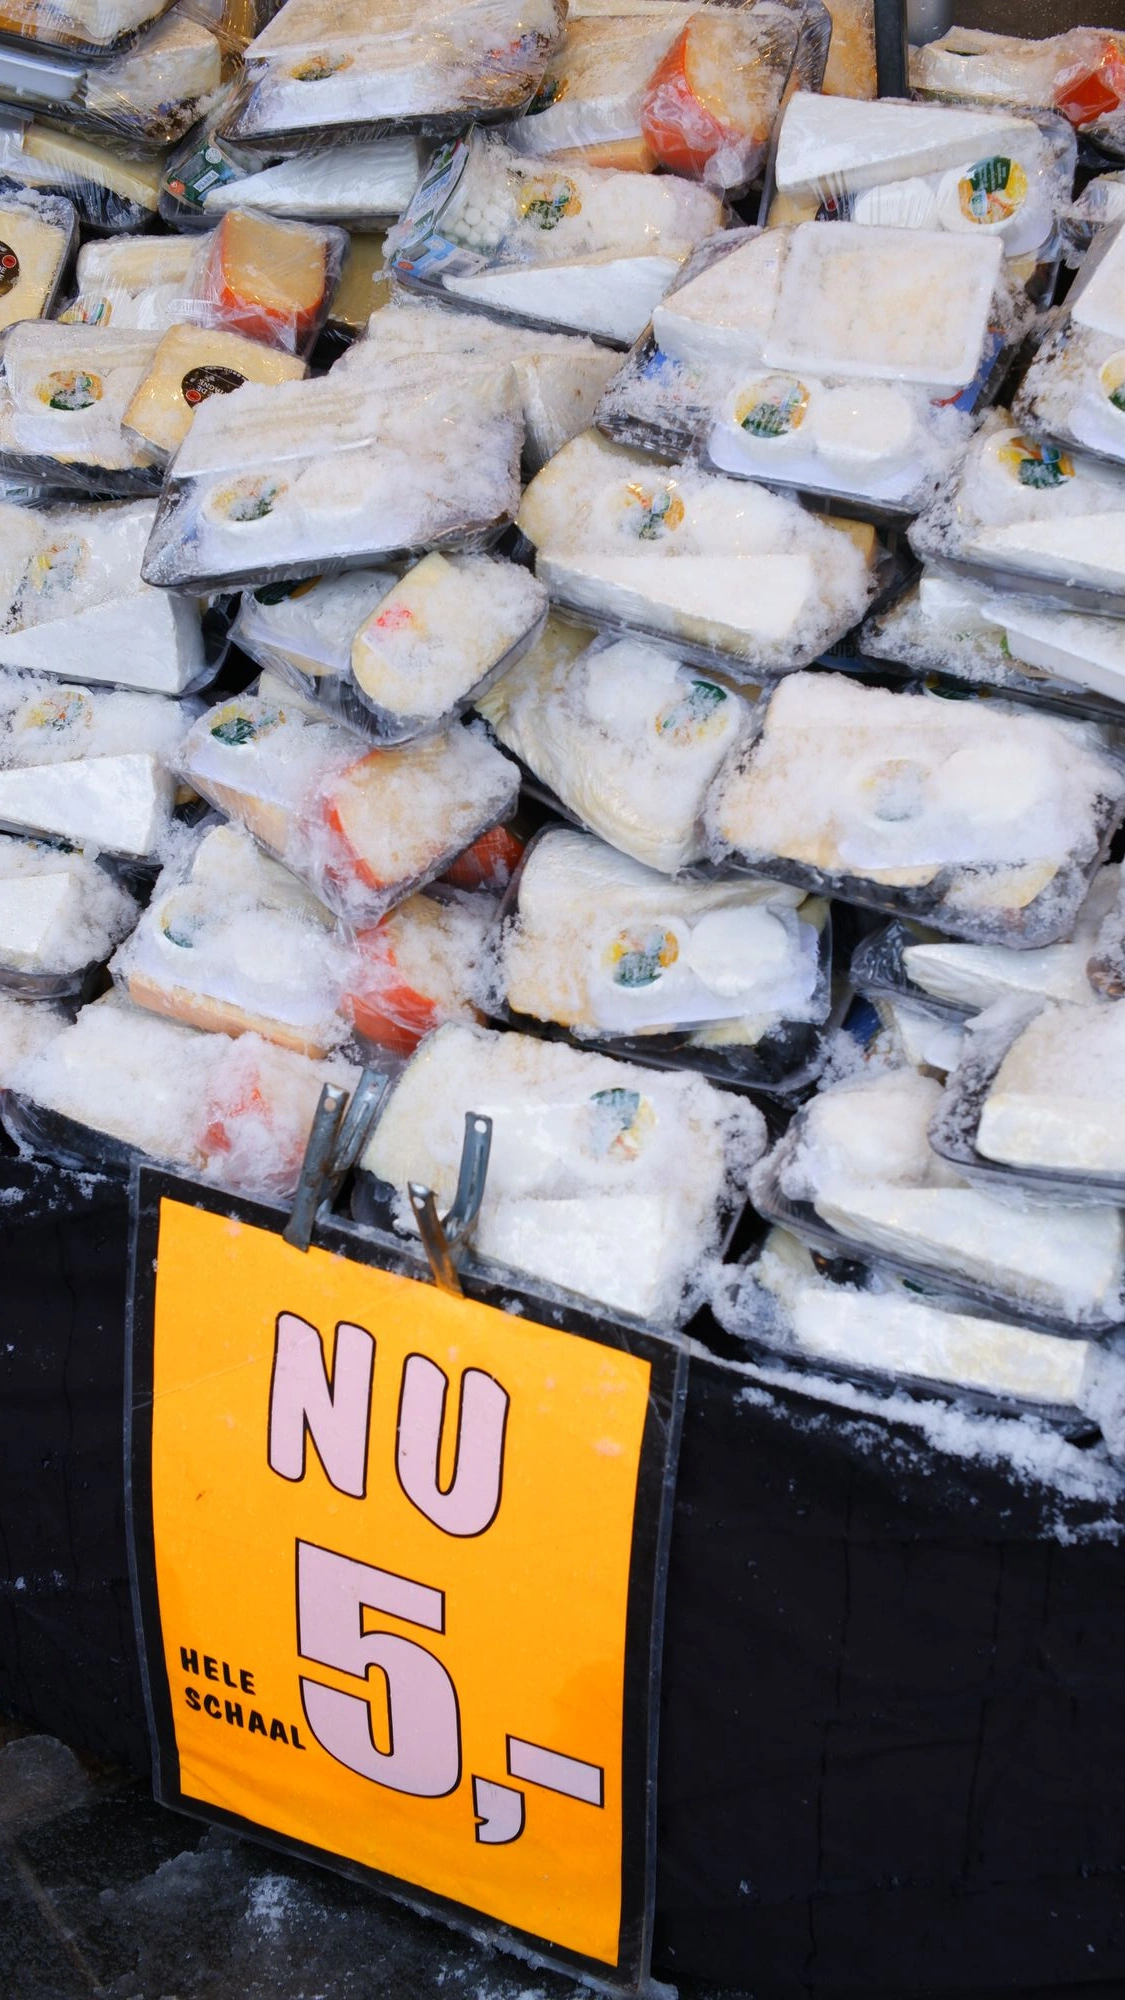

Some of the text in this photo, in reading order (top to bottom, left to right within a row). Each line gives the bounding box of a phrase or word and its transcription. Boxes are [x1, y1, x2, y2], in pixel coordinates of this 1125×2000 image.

[267, 1310, 510, 1538] NU
[180, 1646, 256, 1696] HELE
[185, 1687, 306, 1750] SCHAAL
[295, 1537, 604, 1845] 5,-
